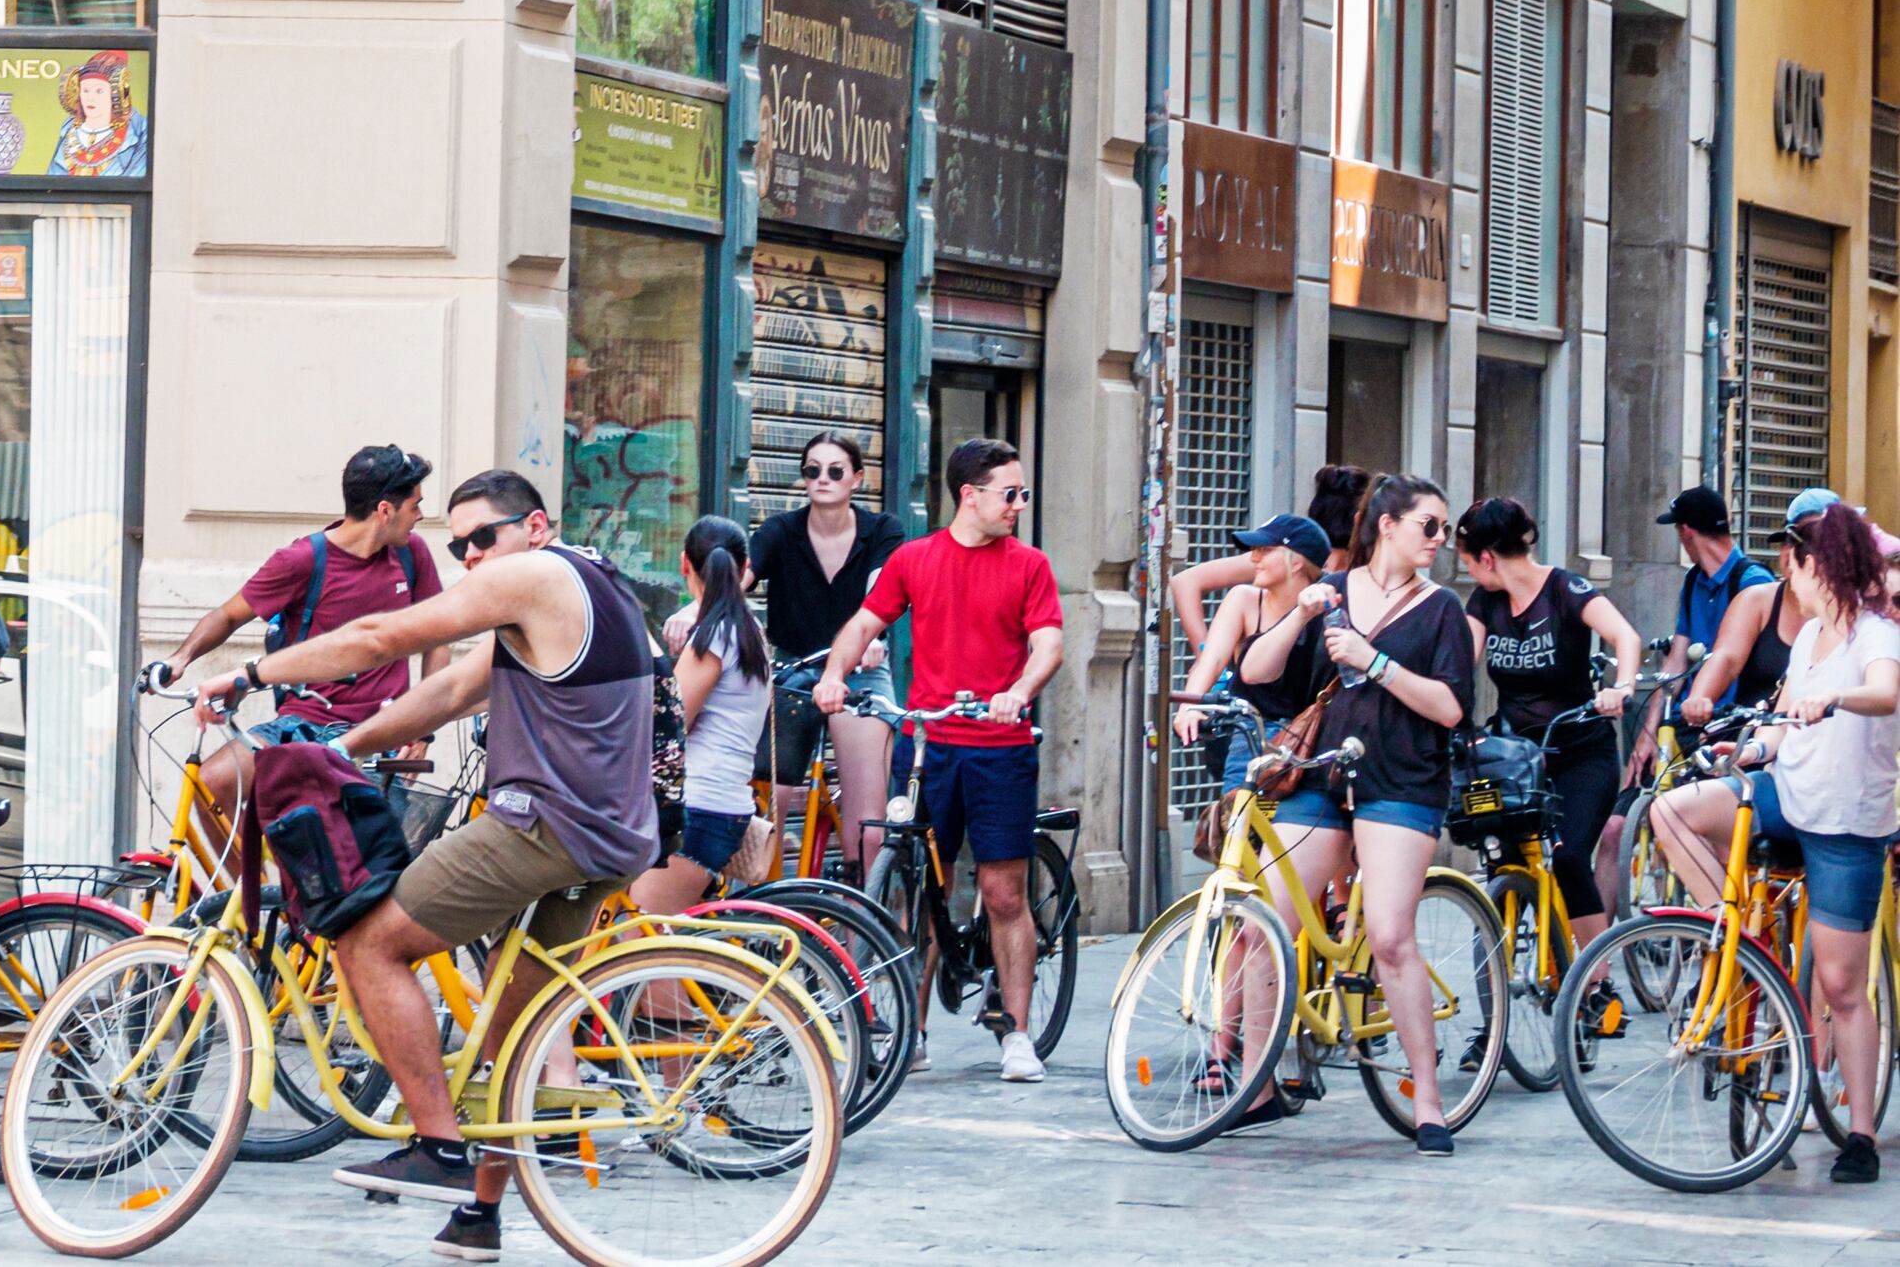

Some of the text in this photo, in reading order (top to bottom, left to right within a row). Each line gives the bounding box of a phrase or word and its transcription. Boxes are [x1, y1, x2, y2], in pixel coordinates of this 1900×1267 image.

[589, 82, 703, 130] INCIENSO DEL TIBET
[770, 63, 892, 174] Yerbas Vivas
[1191, 168, 1284, 252] ROYAL
[1486, 632, 1554, 654] OREGON
